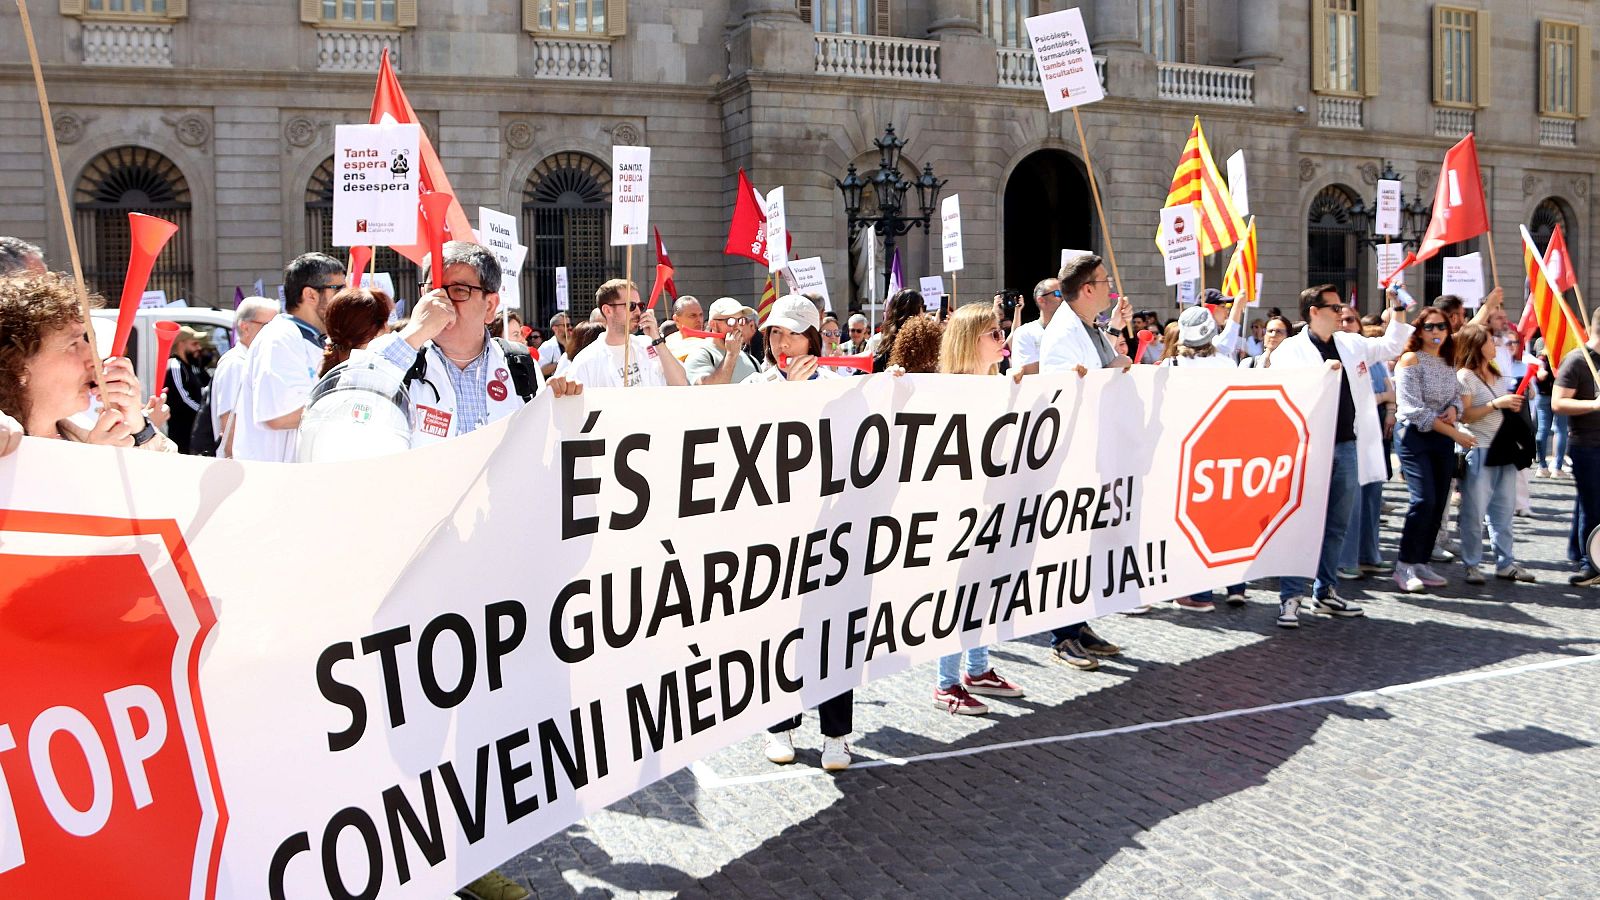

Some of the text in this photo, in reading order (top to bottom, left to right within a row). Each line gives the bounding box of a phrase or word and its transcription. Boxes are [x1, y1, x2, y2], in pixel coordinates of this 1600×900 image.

[1035, 30, 1072, 43] Psicòlegs,
[1037, 38, 1080, 52] odontòlegs,
[1040, 46, 1087, 62] farmacòlegs,
[1043, 56, 1082, 70] també som
[1045, 66, 1084, 80] facultatius
[344, 148, 378, 158] Tanta
[344, 160, 387, 170] espera
[343, 172, 366, 180] ens
[343, 182, 410, 193] desespera
[489, 222, 510, 236] Volem
[488, 238, 512, 250] sanitat
[561, 389, 1062, 540] ÉS EXPLOTACIÓ
[1192, 454, 1293, 503] STOP
[316, 476, 1133, 752] STOP GUÀRDIES DE 24 HORES!
[269, 540, 1168, 900] CONVENI MÈDIC I FACULTATIU JA!!
